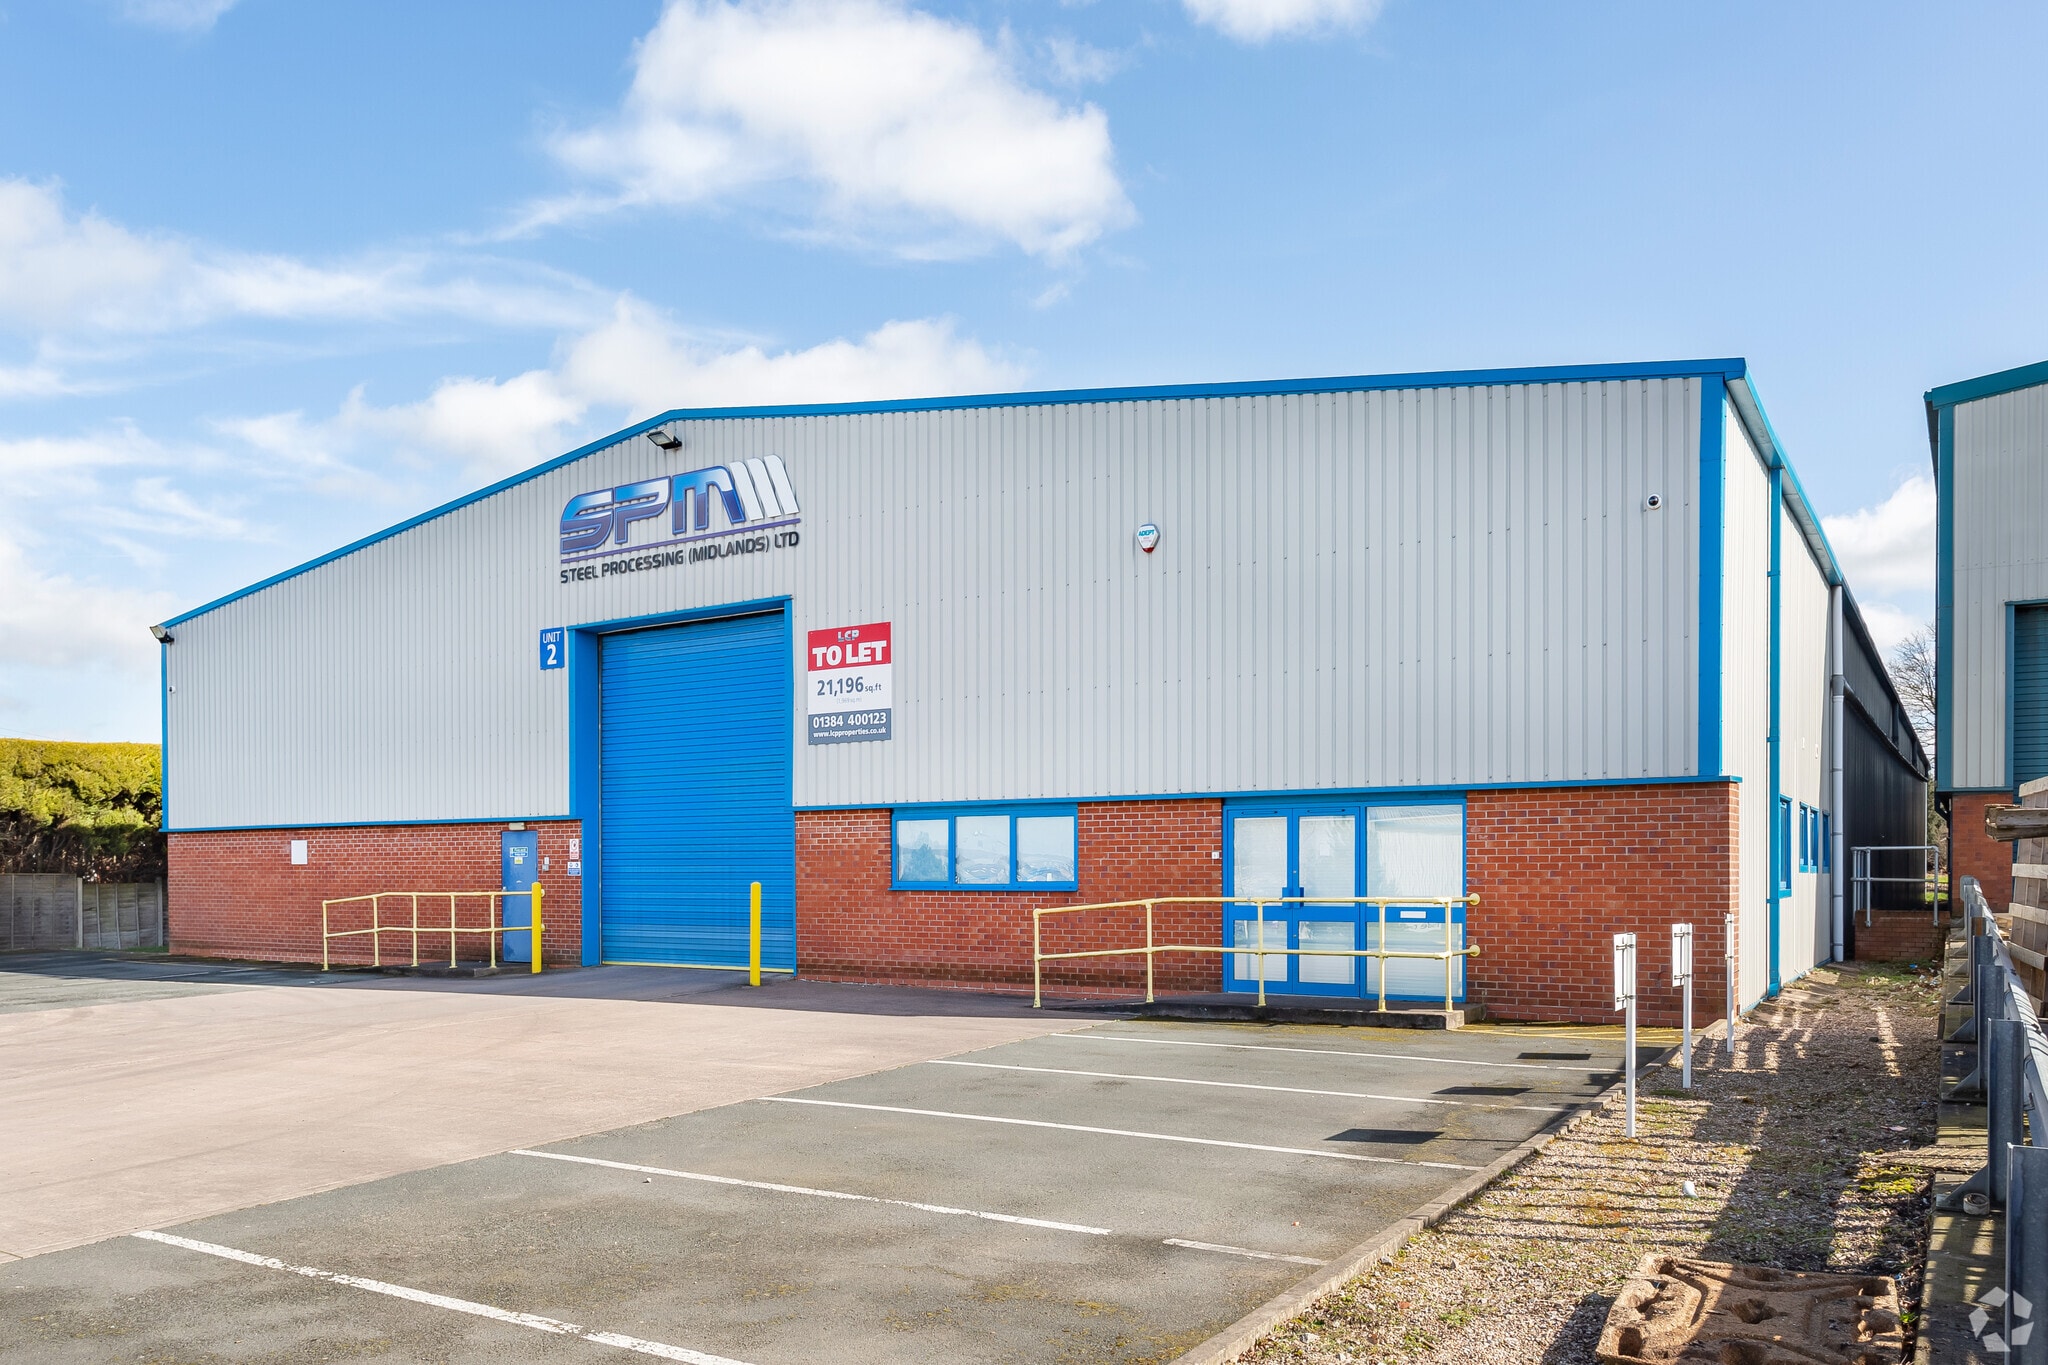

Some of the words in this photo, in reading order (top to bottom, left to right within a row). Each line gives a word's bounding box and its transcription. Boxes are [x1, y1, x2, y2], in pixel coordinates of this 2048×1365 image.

[560, 566, 598, 584] STEEL
[601, 551, 684, 577] PROCESSING
[688, 536, 770, 564] (MIDLANDS)
[774, 531, 799, 549] LTD
[542, 631, 561, 643] UNIT
[837, 629, 859, 642] LCP
[547, 644, 557, 665] 2
[812, 645, 842, 667] TO
[845, 640, 887, 664] LET
[817, 676, 864, 697] 21,196
[813, 716, 843, 728] 01384
[847, 712, 887, 726] 400123
[813, 726, 887, 738] www.lcpproperties.co.uk
